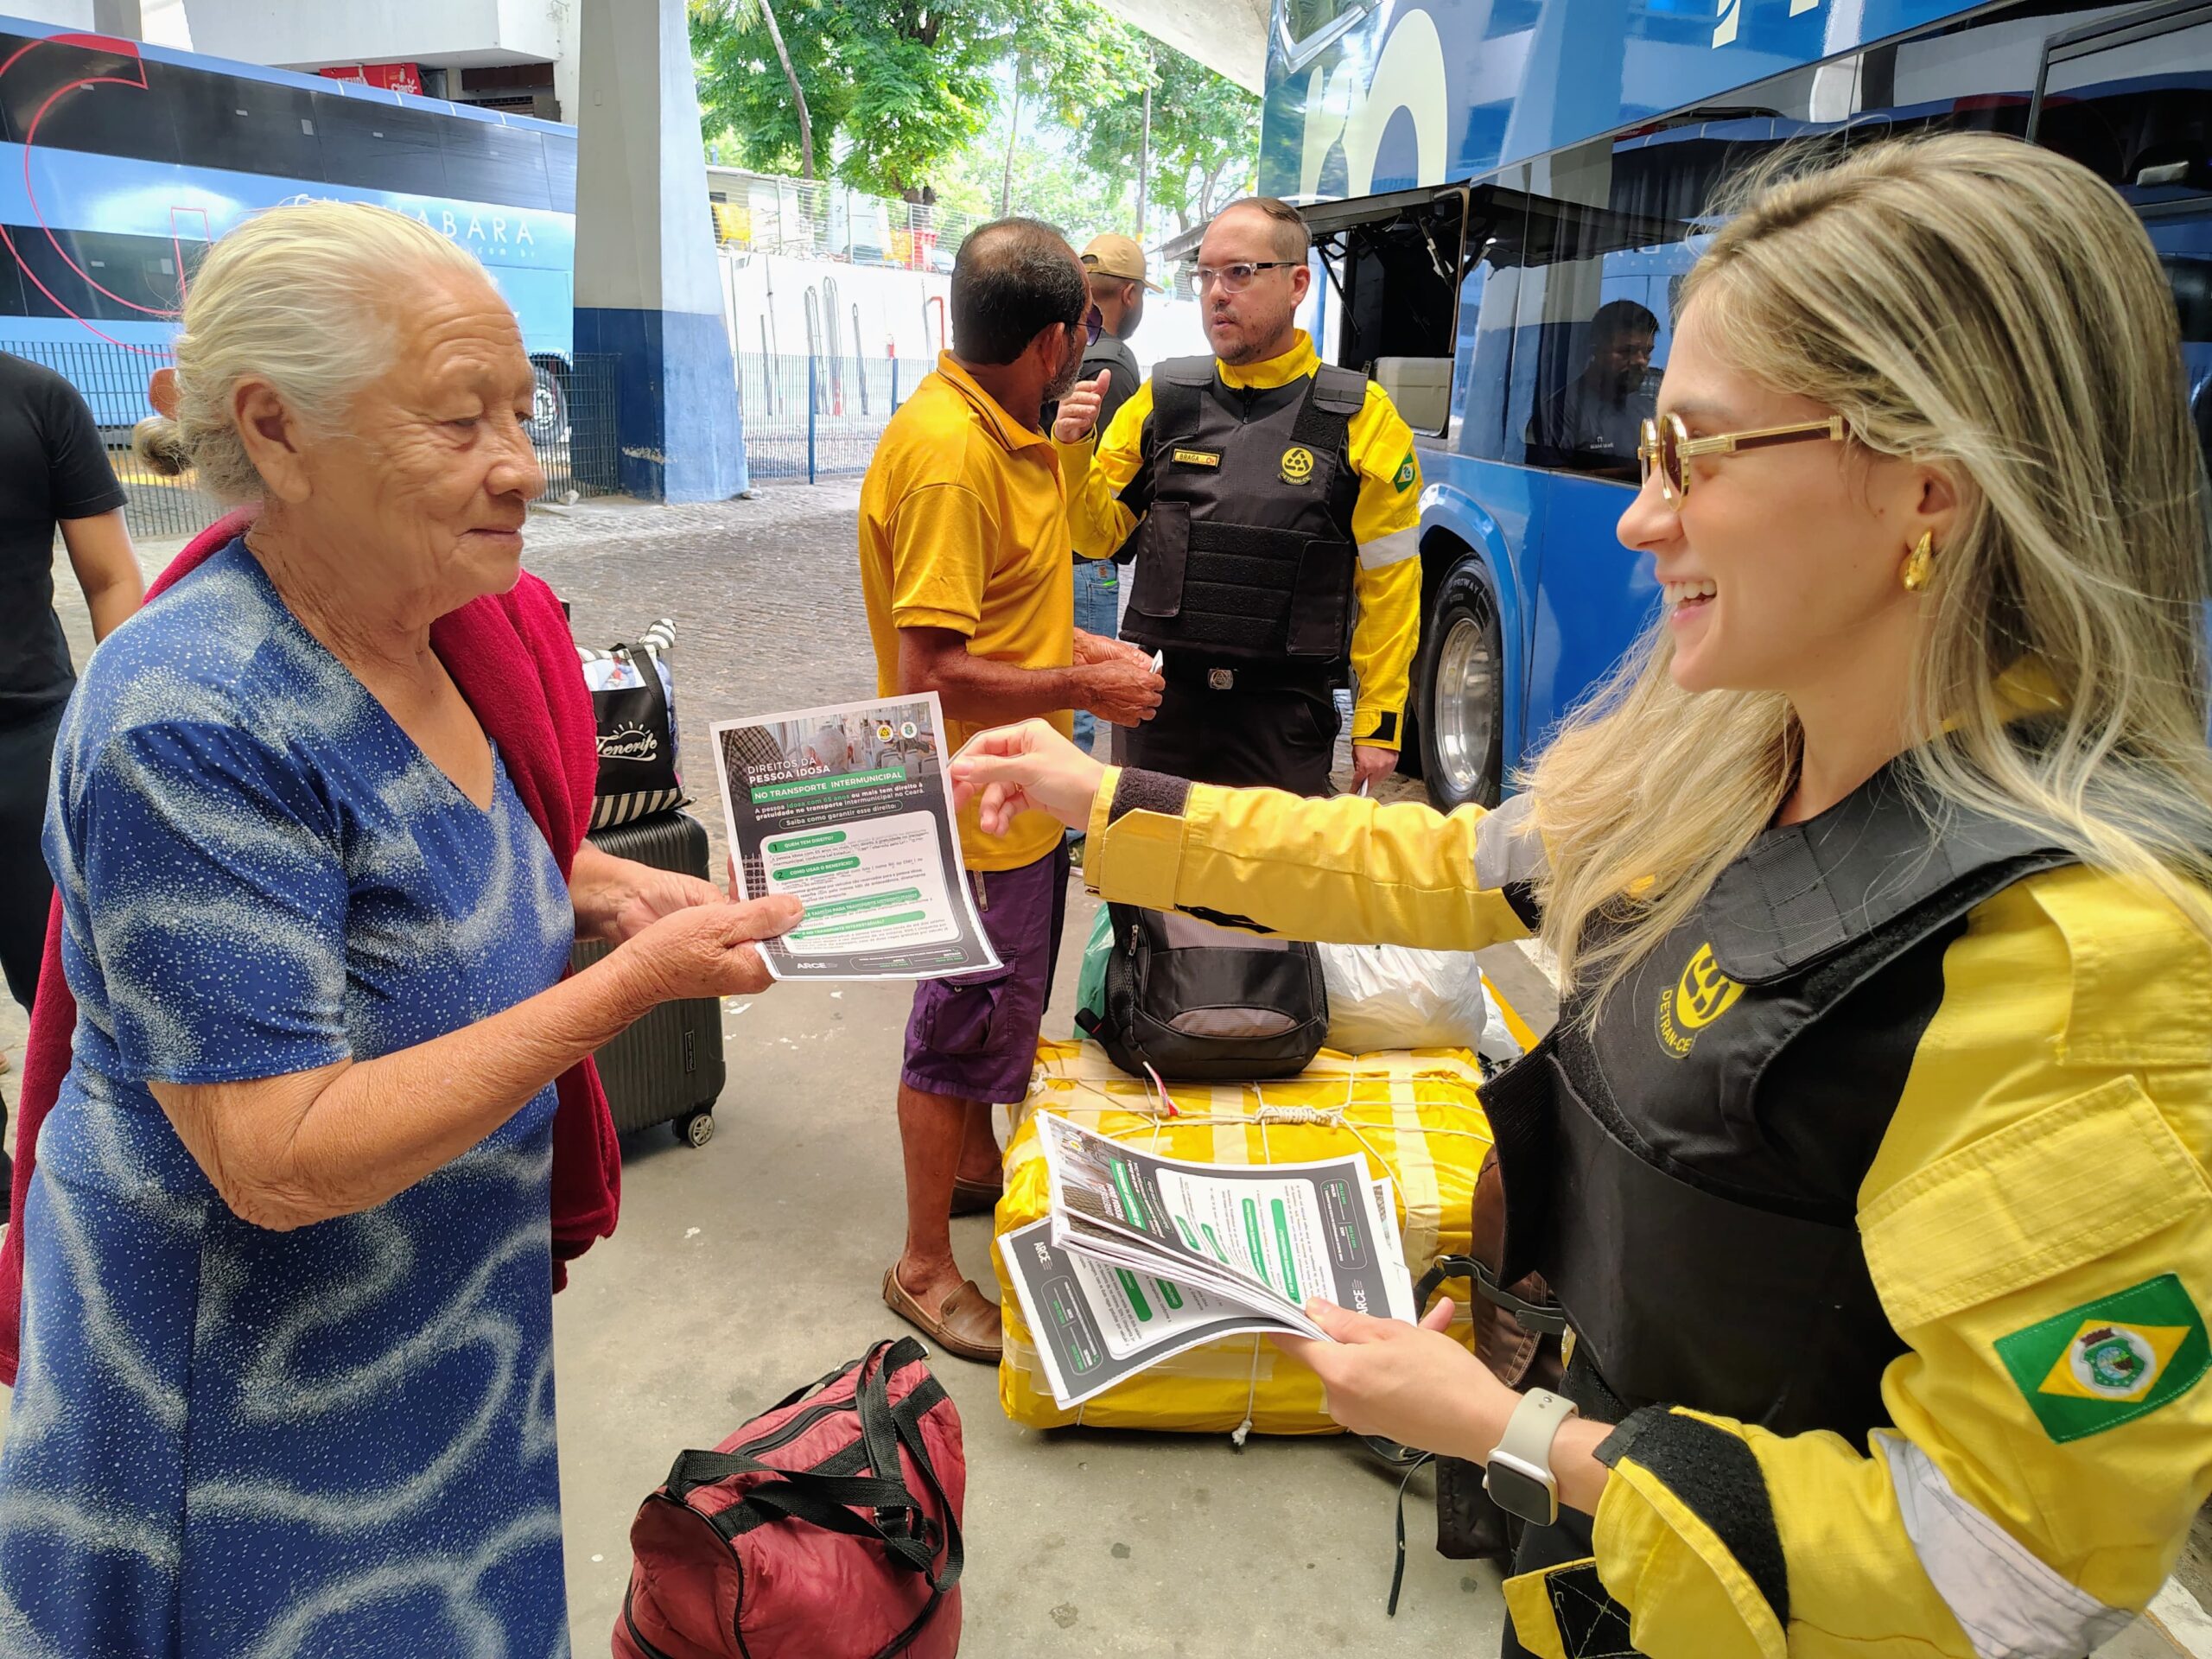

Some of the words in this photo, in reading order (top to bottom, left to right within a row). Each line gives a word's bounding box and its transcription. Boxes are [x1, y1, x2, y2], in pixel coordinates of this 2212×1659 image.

[391, 82, 416, 93] Claro
[1179, 454, 1199, 462] BRAGA
[748, 760, 797, 774] DIREITOS
[801, 757, 817, 766] DA
[749, 770, 793, 785] PESSOA
[796, 765, 830, 777] IDOSA
[770, 783, 827, 797] TRANSPORTE
[831, 771, 902, 788] INTERMUNICIPAL
[762, 805, 785, 814] pessoa
[894, 783, 917, 791] direito
[756, 809, 795, 821] gratuidade
[806, 801, 843, 812] transporte
[786, 818, 805, 826] Saiba
[827, 809, 855, 820] garantir
[778, 871, 784, 880] 2
[1660, 989, 1693, 1052] DETRAN-CE
[1034, 1242, 1051, 1264] ARCE
